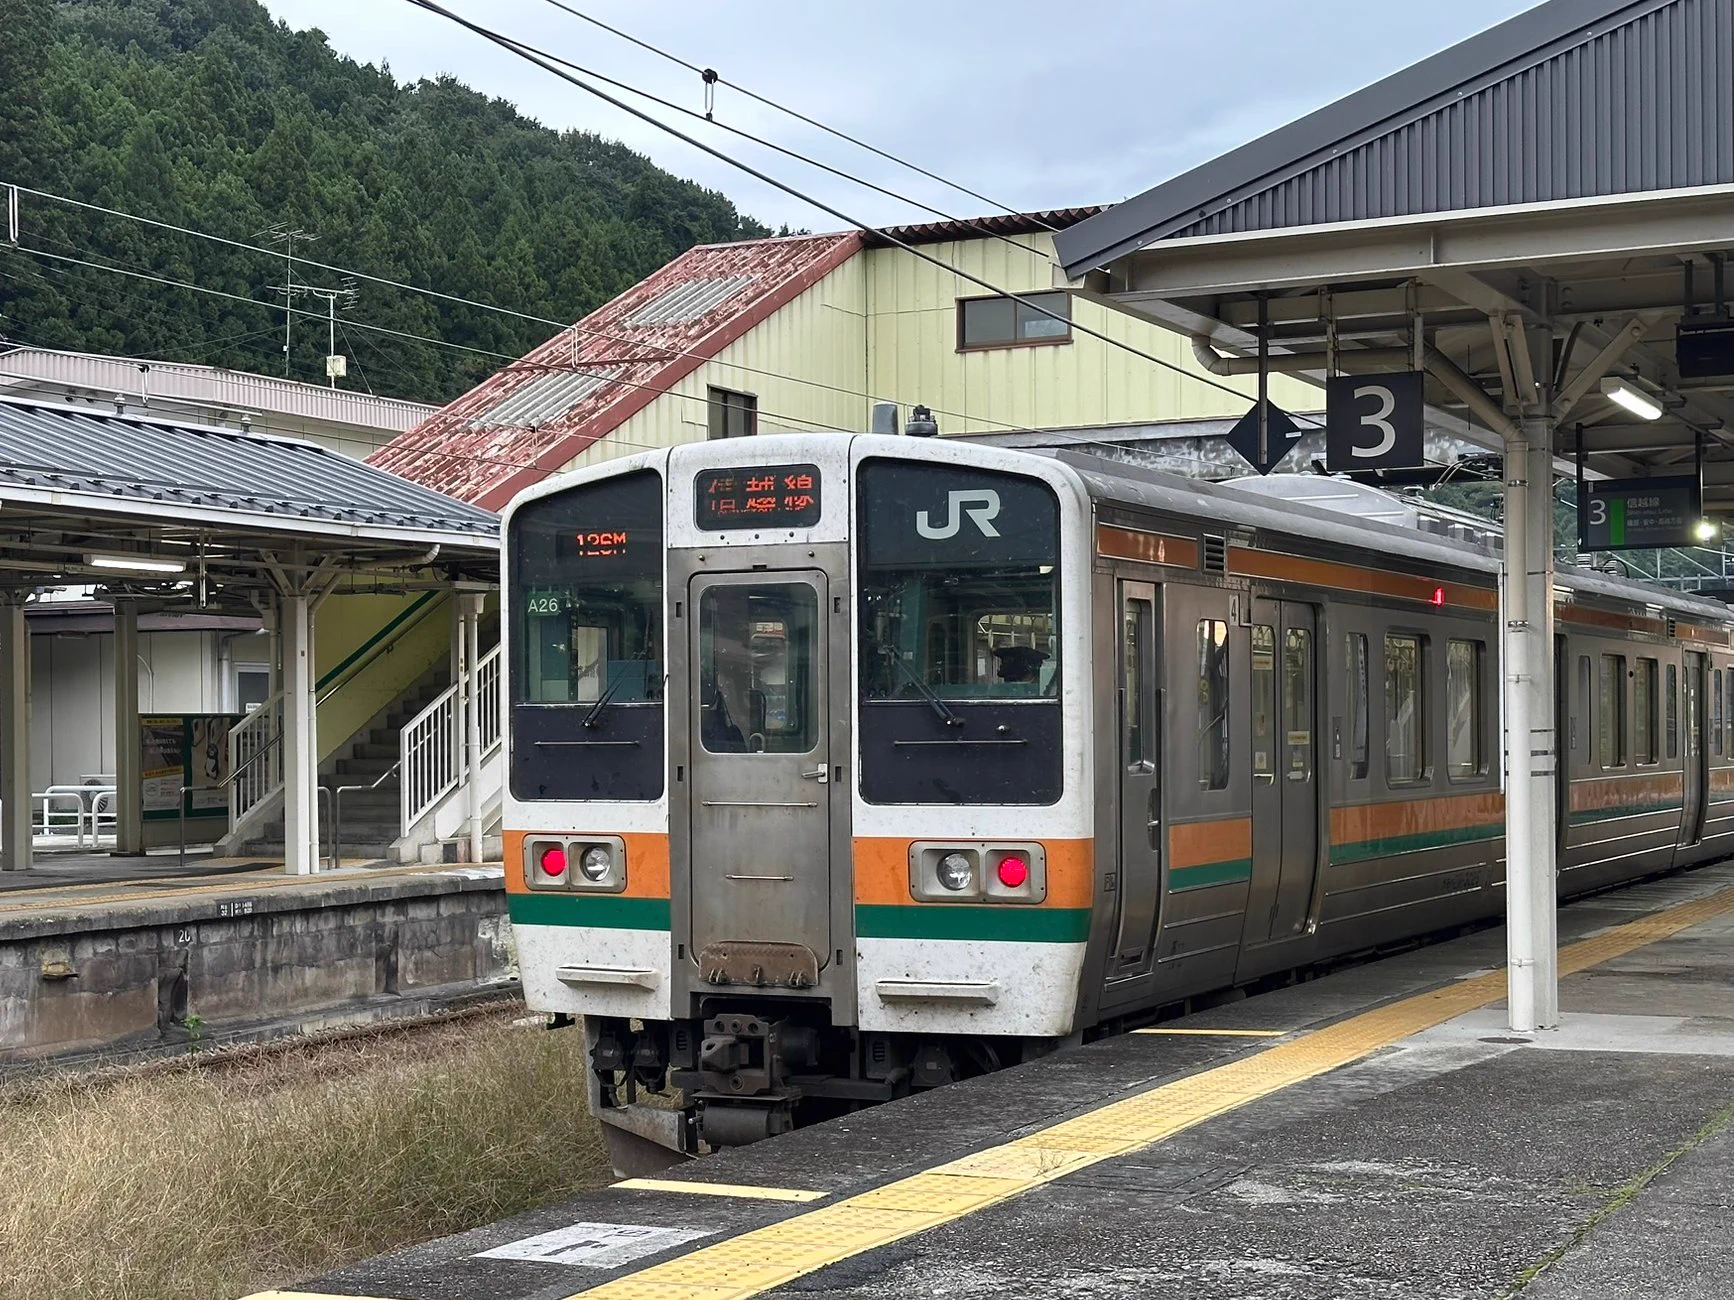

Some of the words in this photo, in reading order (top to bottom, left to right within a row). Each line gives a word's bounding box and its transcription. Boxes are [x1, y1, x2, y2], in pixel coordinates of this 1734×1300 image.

[1352, 385, 1396, 458] 3
[916, 489, 1001, 540] JR
[1589, 499, 1606, 525] 3
[527, 598, 558, 613] A26
